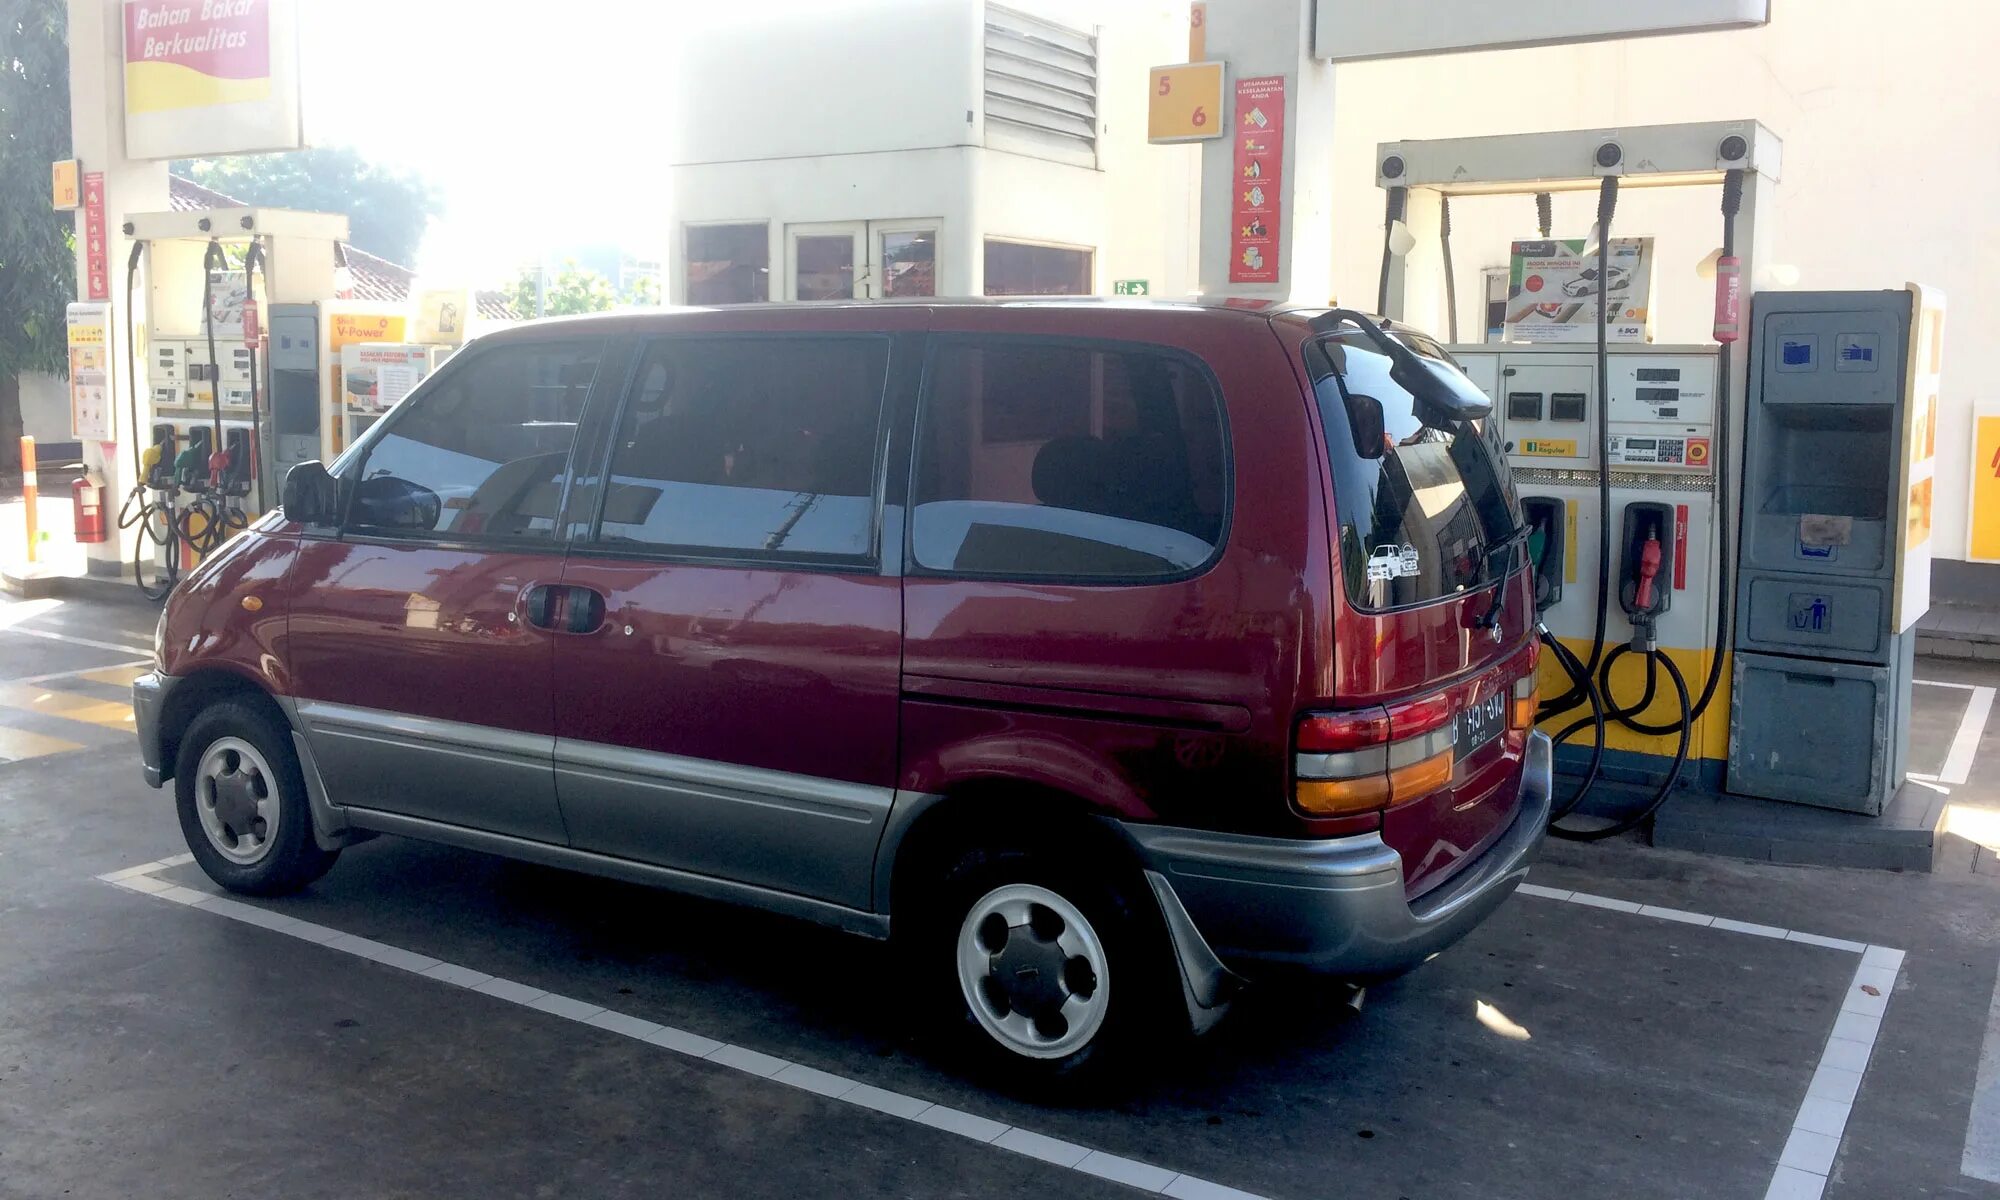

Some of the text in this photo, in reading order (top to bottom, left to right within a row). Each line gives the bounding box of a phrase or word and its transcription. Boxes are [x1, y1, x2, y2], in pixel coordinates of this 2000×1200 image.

[137, 0, 254, 29] Bahan Bakar
[1191, 8, 1202, 28] 3
[144, 27, 247, 58] Berkualitas
[1159, 76, 1171, 96] 5
[1191, 106, 1206, 127] 6
[337, 326, 385, 337] V-Power
[1539, 446, 1565, 455] Regular
[1452, 714, 1459, 745] B
